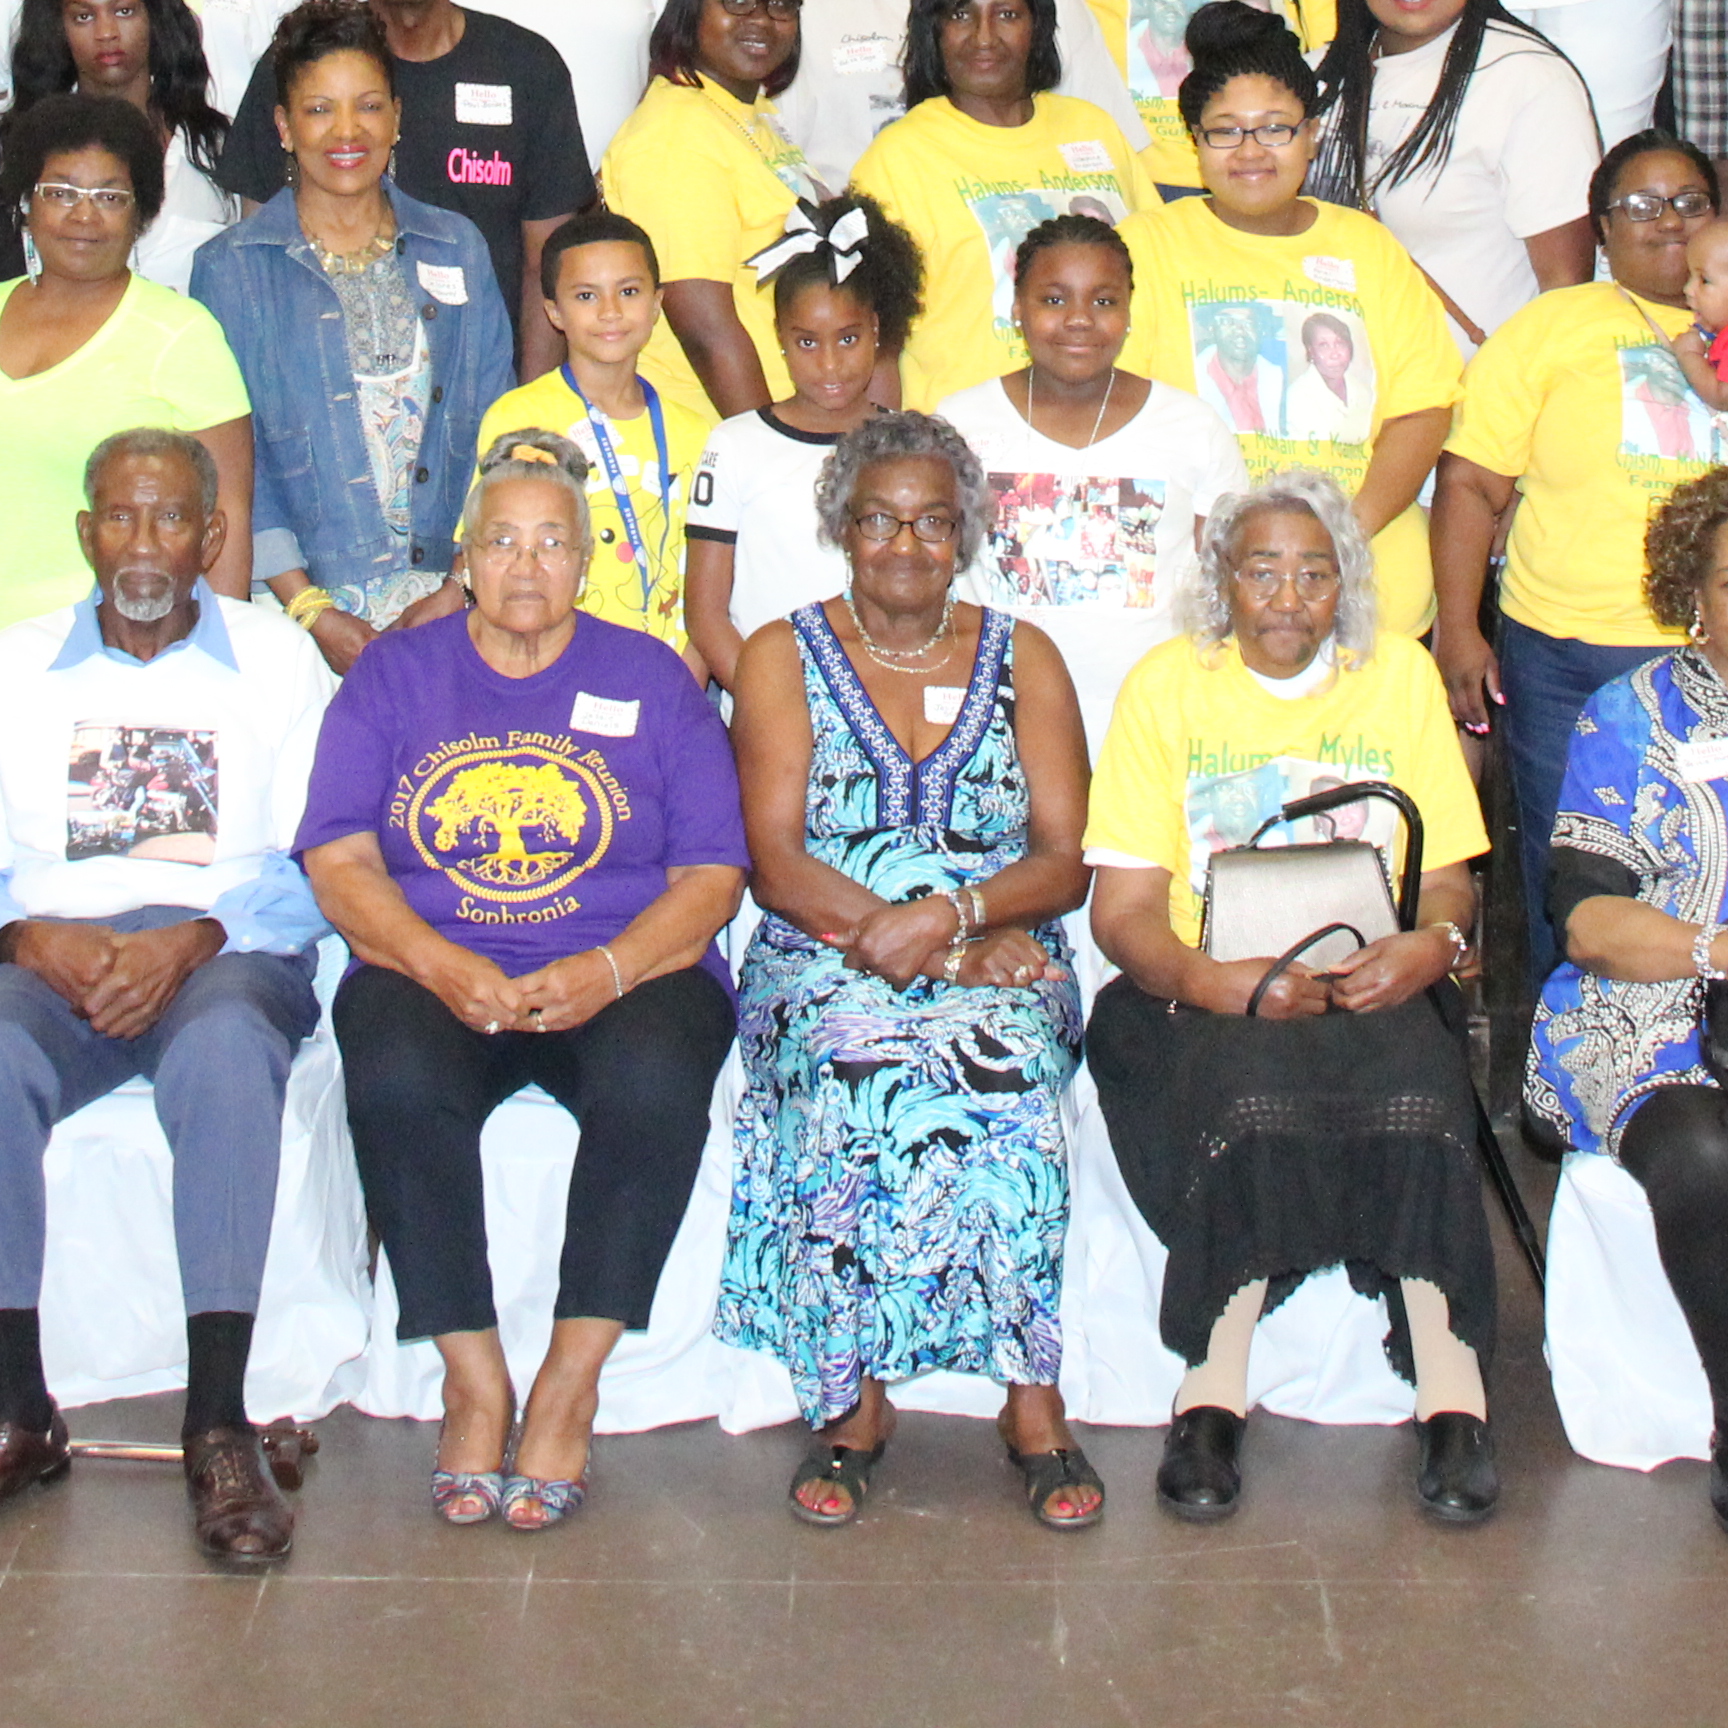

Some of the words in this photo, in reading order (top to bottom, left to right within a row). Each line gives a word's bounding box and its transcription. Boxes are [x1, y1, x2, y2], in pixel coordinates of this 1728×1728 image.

[448, 147, 512, 186] Chisolm
[388, 774, 417, 829] 2017
[412, 731, 502, 778] Chisolm
[506, 729, 581, 758] Family
[576, 747, 633, 822] Reunion
[1318, 732, 1395, 782] Myles
[456, 895, 581, 925] Sophronia
